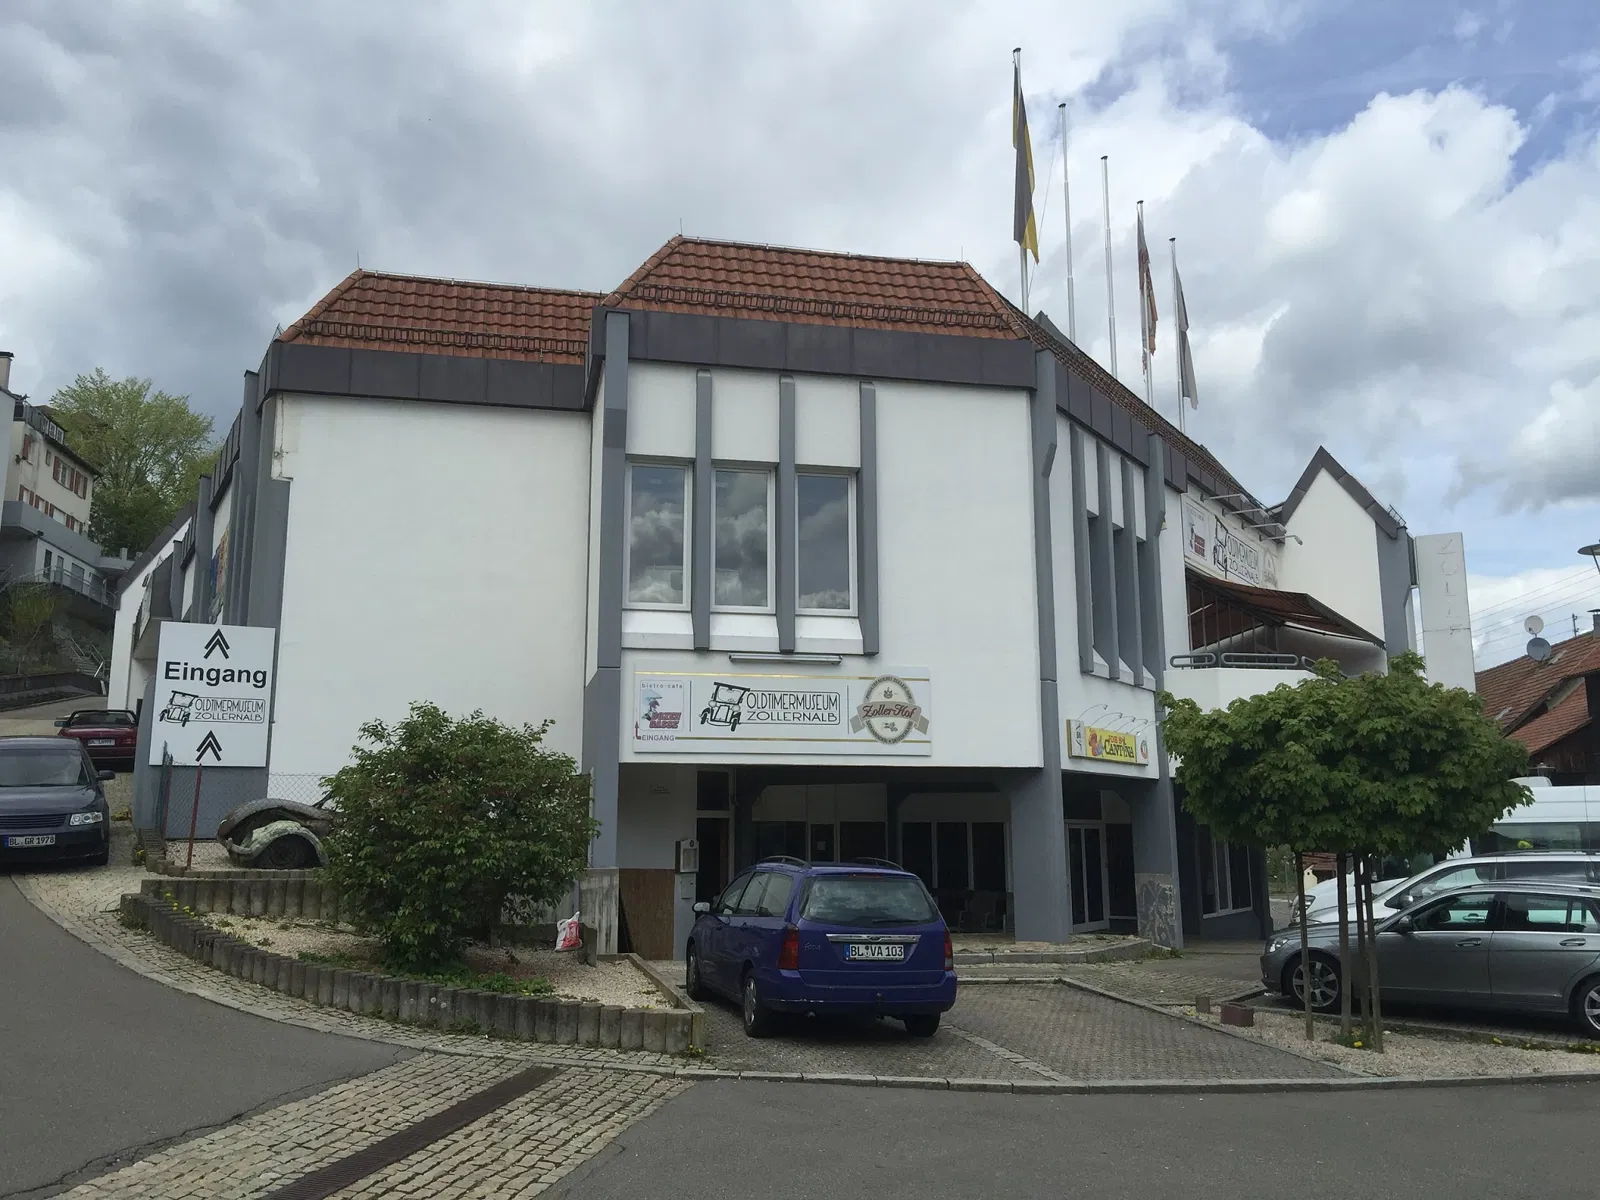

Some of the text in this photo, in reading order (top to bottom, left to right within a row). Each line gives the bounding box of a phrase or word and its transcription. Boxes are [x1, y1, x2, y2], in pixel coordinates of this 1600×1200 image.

[164, 661, 267, 688] Eingang
[195, 698, 263, 712] OLDTIMERMUSEUM
[746, 692, 838, 711] OLDTIMERMUSEUM
[194, 712, 262, 721] ZOLLERNALB
[747, 711, 838, 722] ZOLLERNALB
[10, 838, 19, 846] BL
[24, 837, 34, 845] GR
[850, 945, 903, 957] BL VA 103
